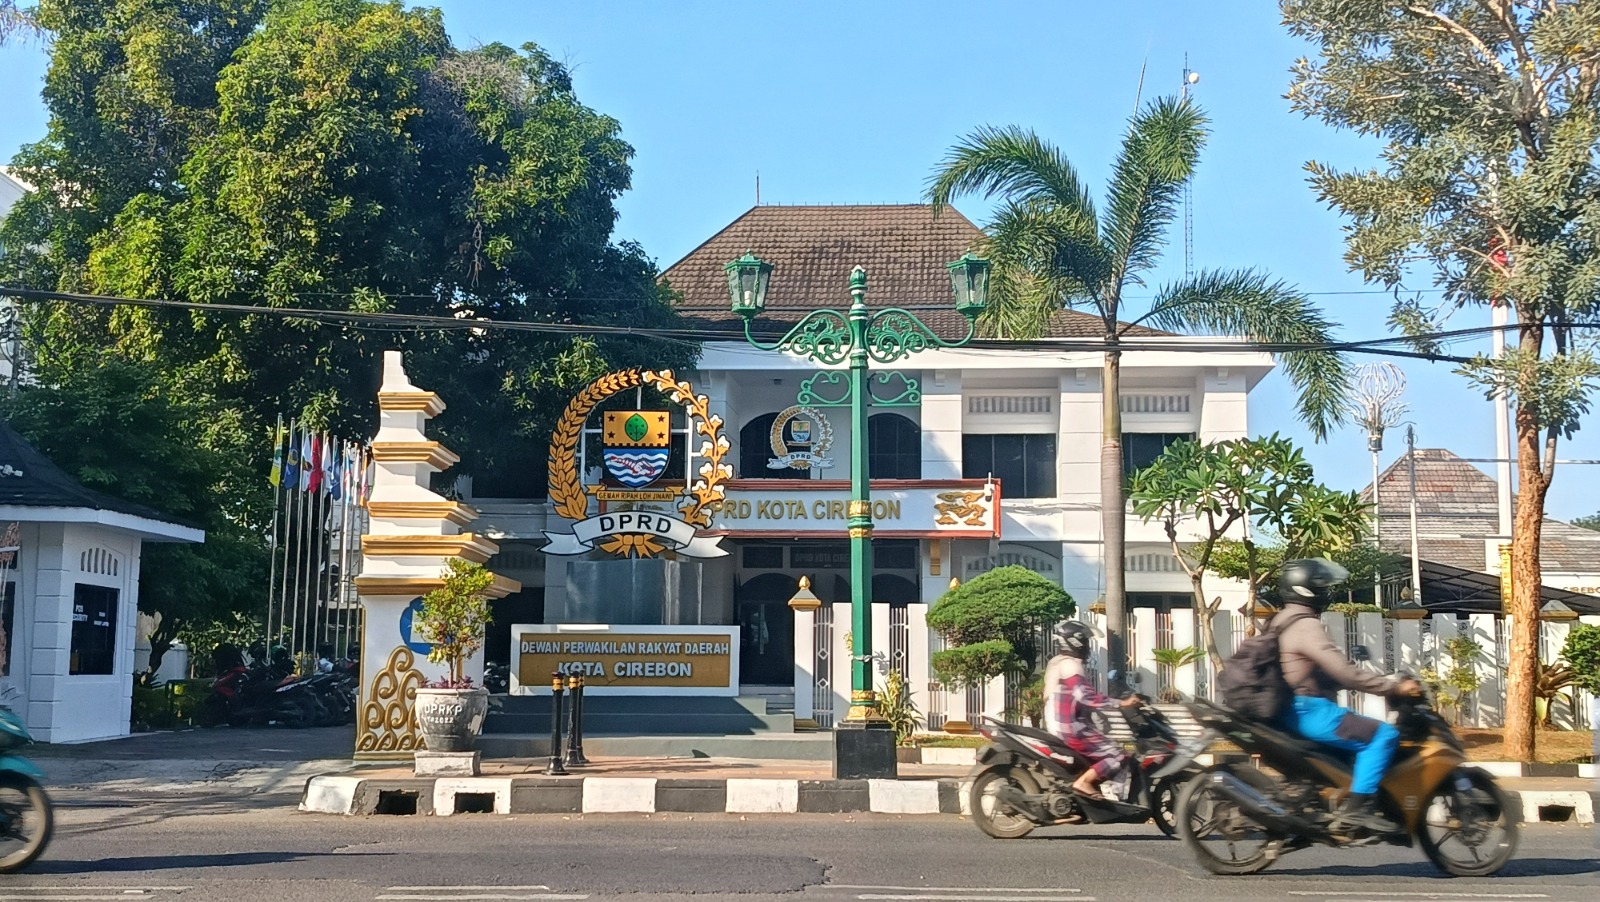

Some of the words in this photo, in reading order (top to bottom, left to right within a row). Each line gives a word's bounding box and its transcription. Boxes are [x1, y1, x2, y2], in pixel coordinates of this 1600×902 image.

[621, 491, 638, 499] RIPAH
[639, 491, 652, 500] LOH
[709, 499, 752, 520] PRD
[757, 499, 808, 520] KOTA
[600, 514, 672, 534] DPRD
[521, 641, 561, 654] DEWAN
[563, 641, 636, 655] PERWAKILAN
[638, 642, 682, 655] RAKYAT
[684, 642, 730, 655] DAERAH
[558, 661, 605, 677] KOTA
[613, 661, 692, 677] CIREBON
